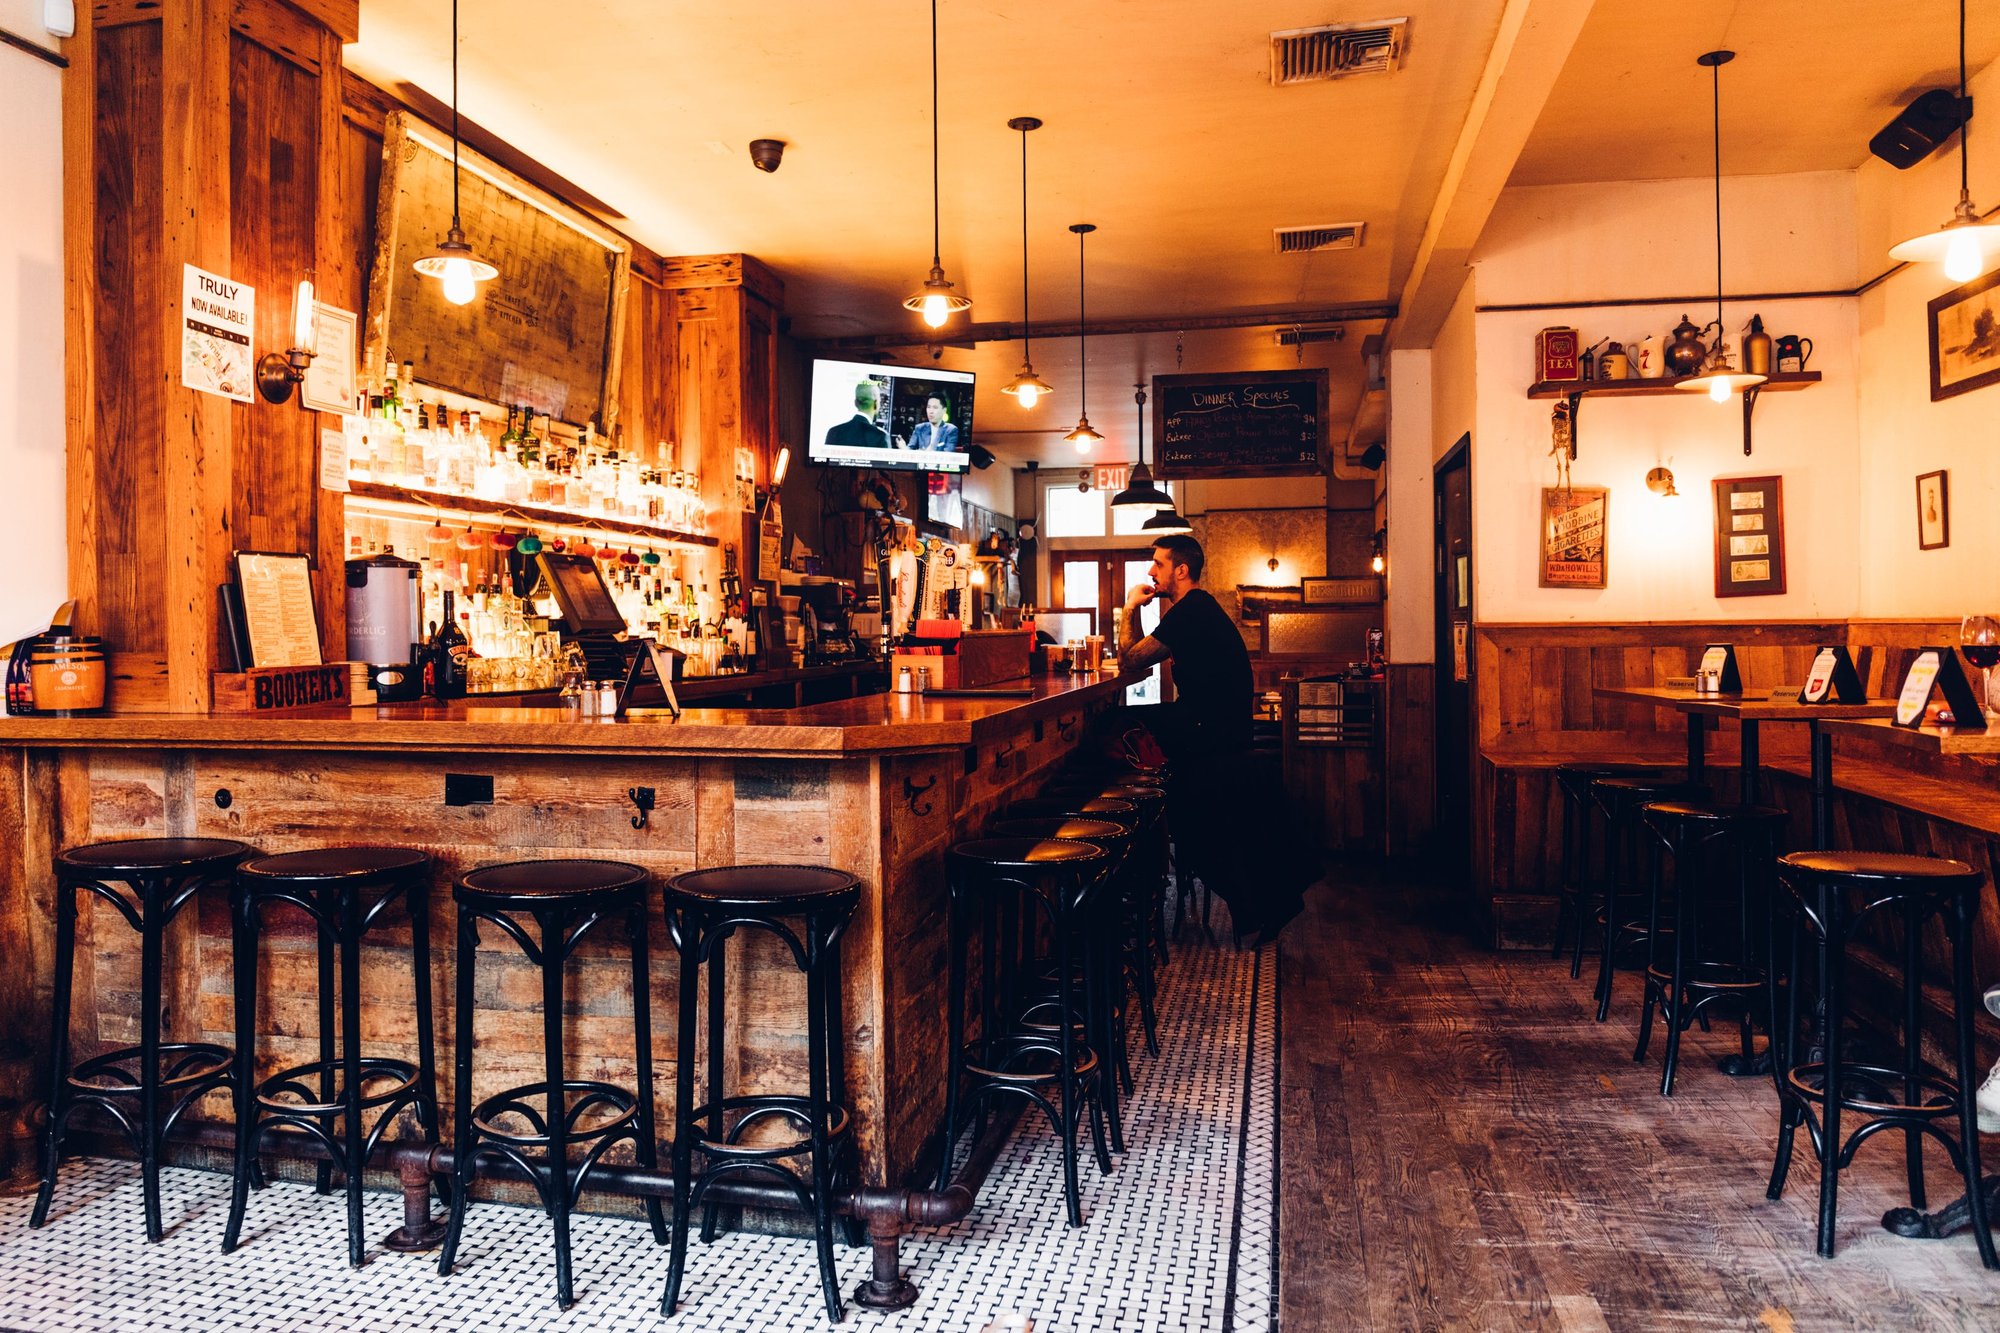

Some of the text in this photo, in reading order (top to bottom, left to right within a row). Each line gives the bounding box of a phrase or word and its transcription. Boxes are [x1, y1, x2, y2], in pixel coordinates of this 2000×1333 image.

[198, 275, 238, 300] TRULY
[191, 297, 248, 326] NOW AVAILABLE!
[1547, 359, 1573, 369] TEA
[1192, 391, 1239, 408] DINNER
[1098, 469, 1126, 489] EXIT
[1557, 511, 1578, 523] WILD
[1552, 527, 1600, 552] CIGARETTES
[49, 663, 88, 672] JAMESON
[255, 667, 343, 709] BOOKER'S
